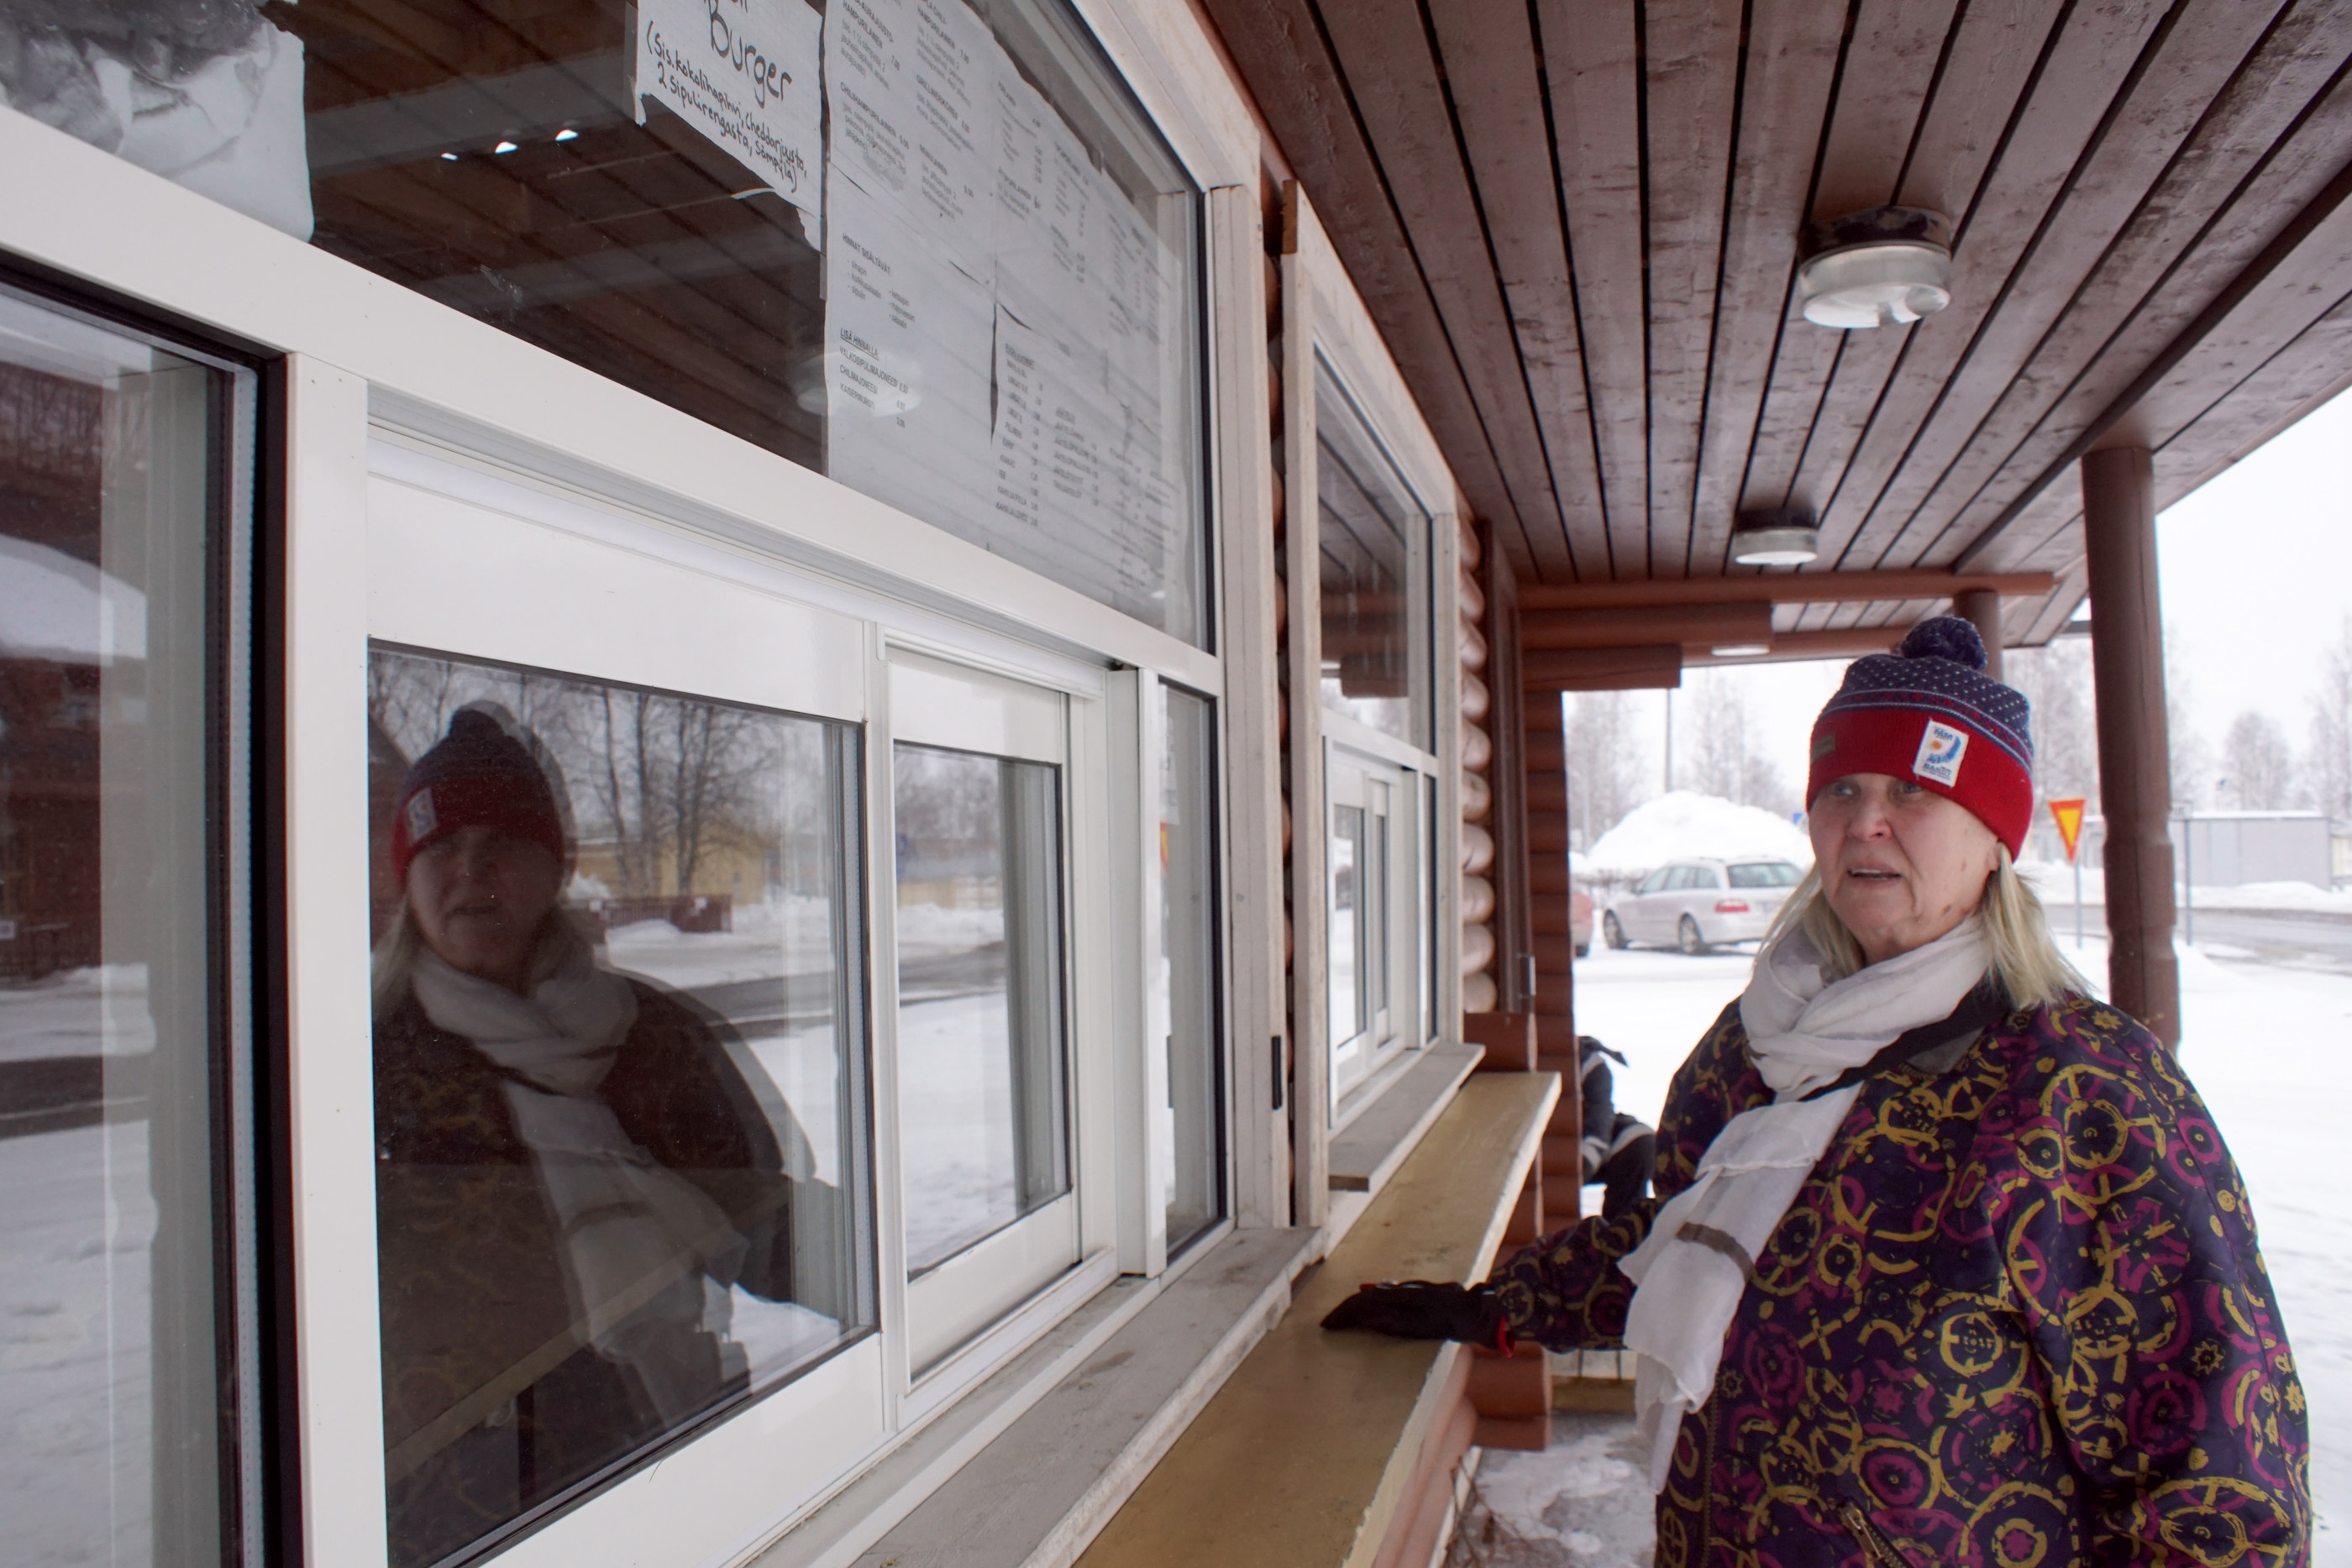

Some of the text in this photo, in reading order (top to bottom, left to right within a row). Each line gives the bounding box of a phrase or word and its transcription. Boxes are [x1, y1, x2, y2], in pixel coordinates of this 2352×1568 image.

[843, 1, 883, 50] HAMPURILAINEN
[705, 0, 792, 109] Burger
[658, 60, 667, 89] 2
[843, 233, 861, 254] HINNAT
[840, 327, 853, 341] LISÄ
[840, 344, 898, 389] VALKOSIPULIMAJONEESI
